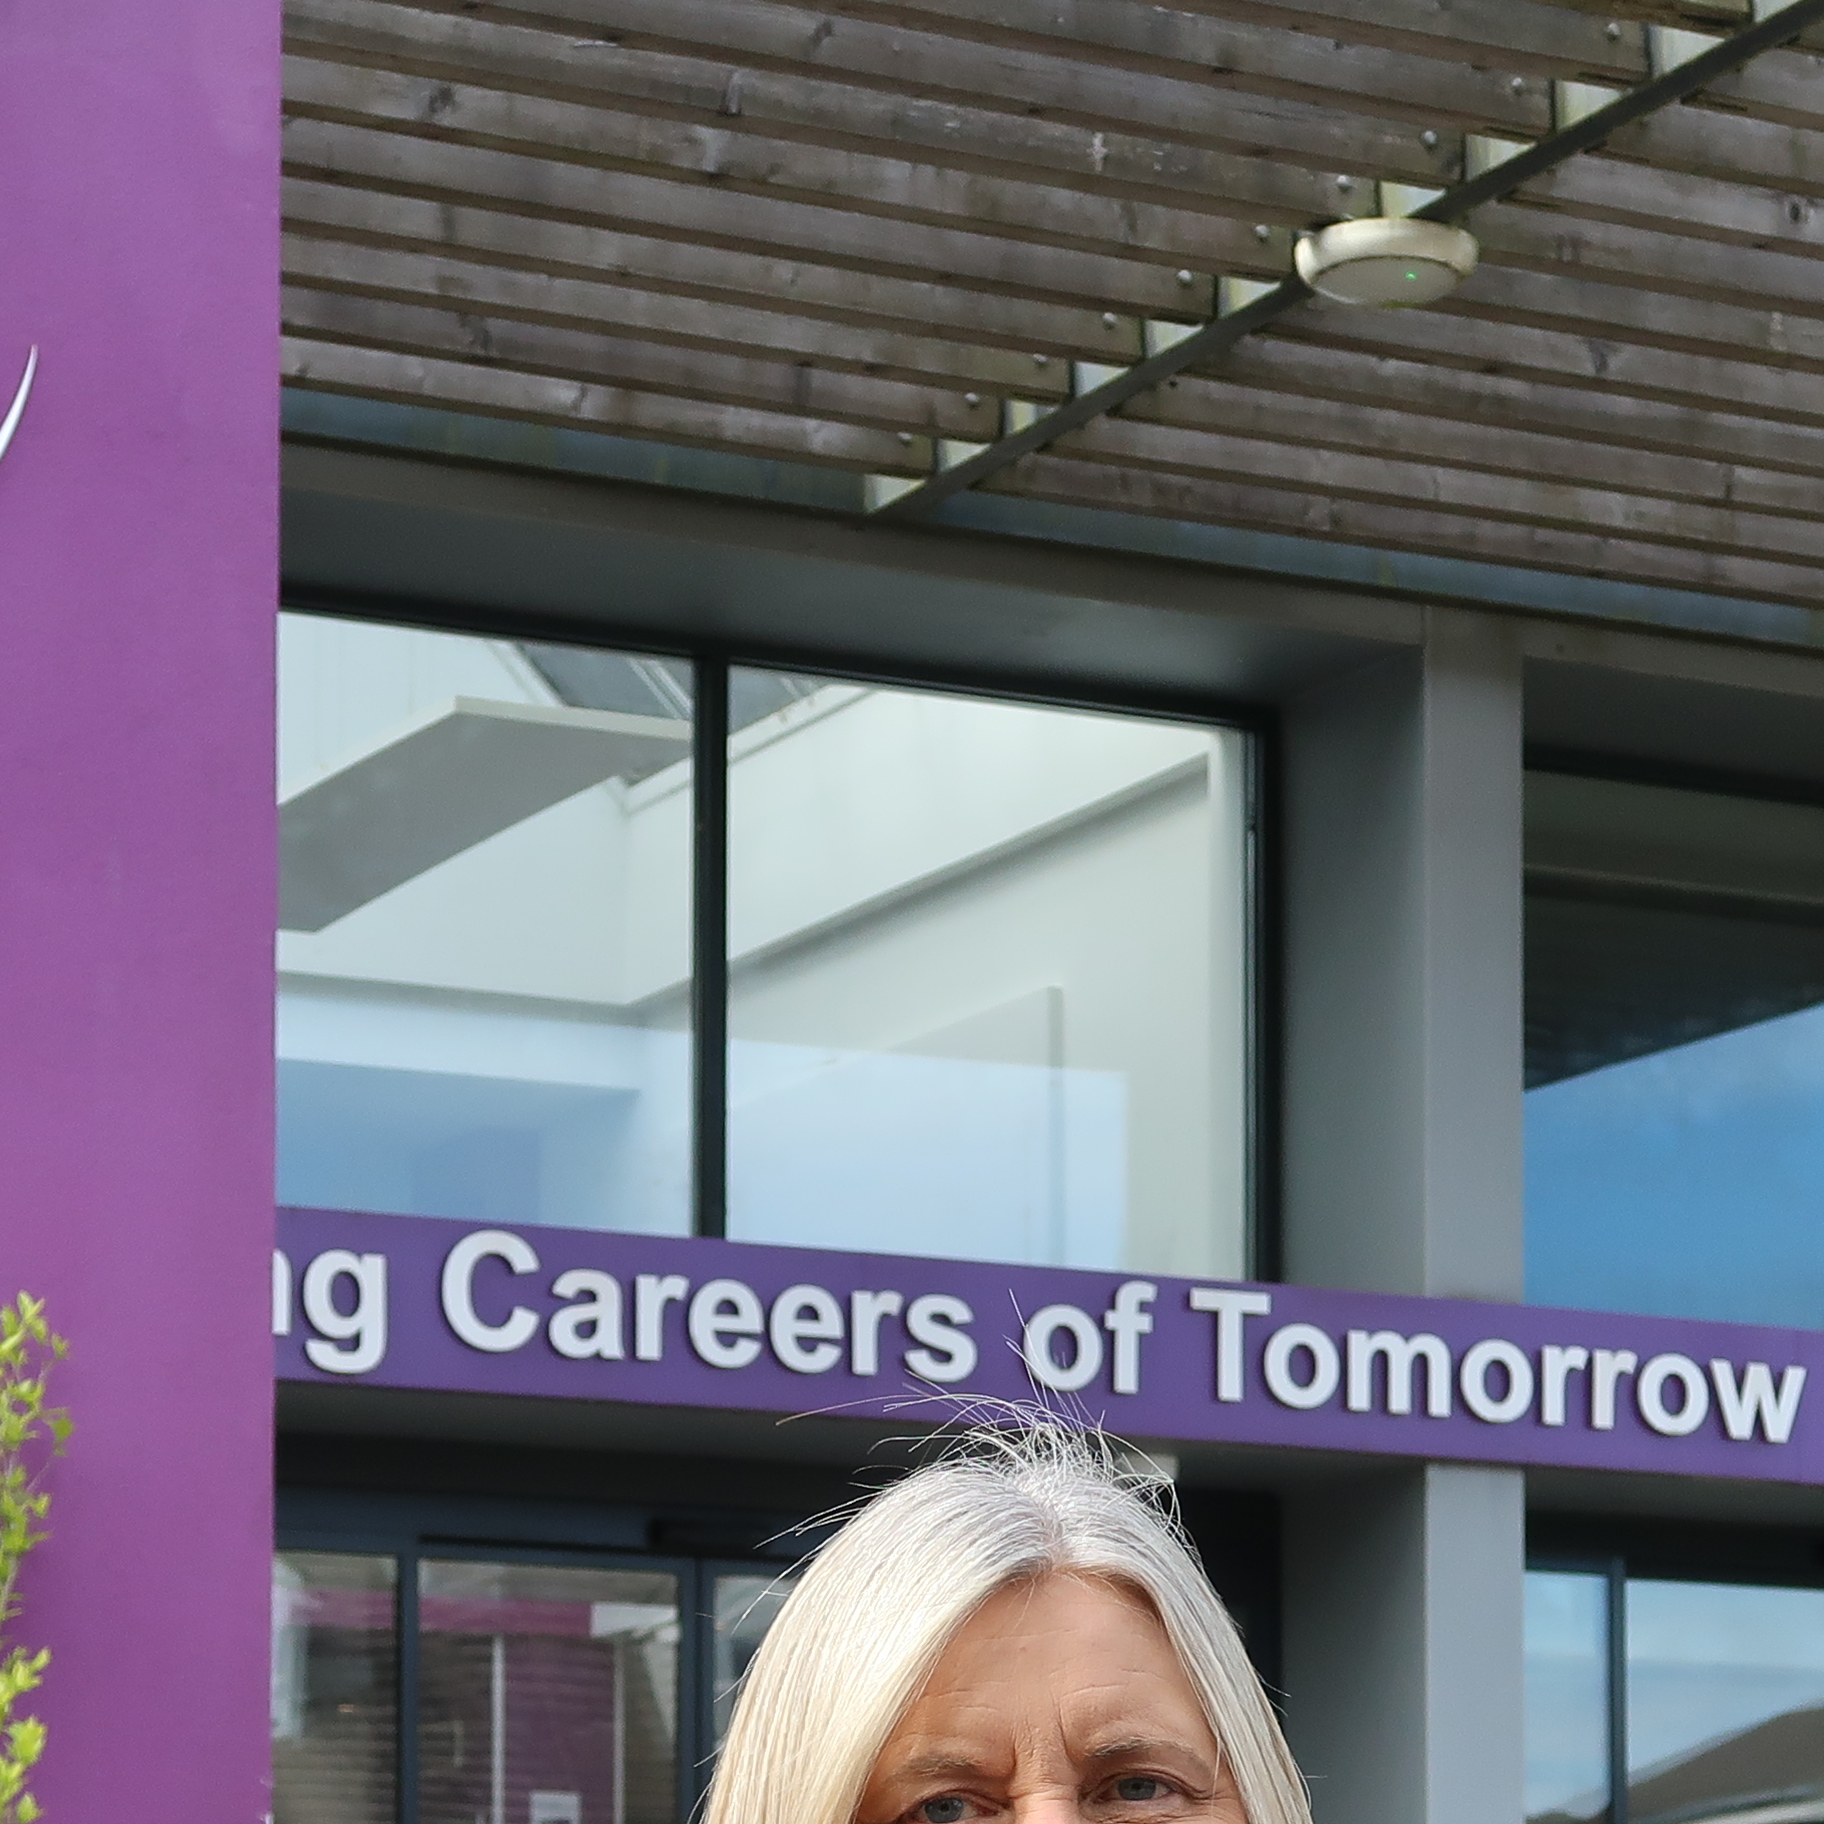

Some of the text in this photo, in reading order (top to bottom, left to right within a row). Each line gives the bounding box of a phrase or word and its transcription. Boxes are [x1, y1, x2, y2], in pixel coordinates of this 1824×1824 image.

[440, 1228, 979, 1386] Careers
[1022, 1281, 1159, 1396] of
[1188, 1285, 1808, 1448] Tomorrow
